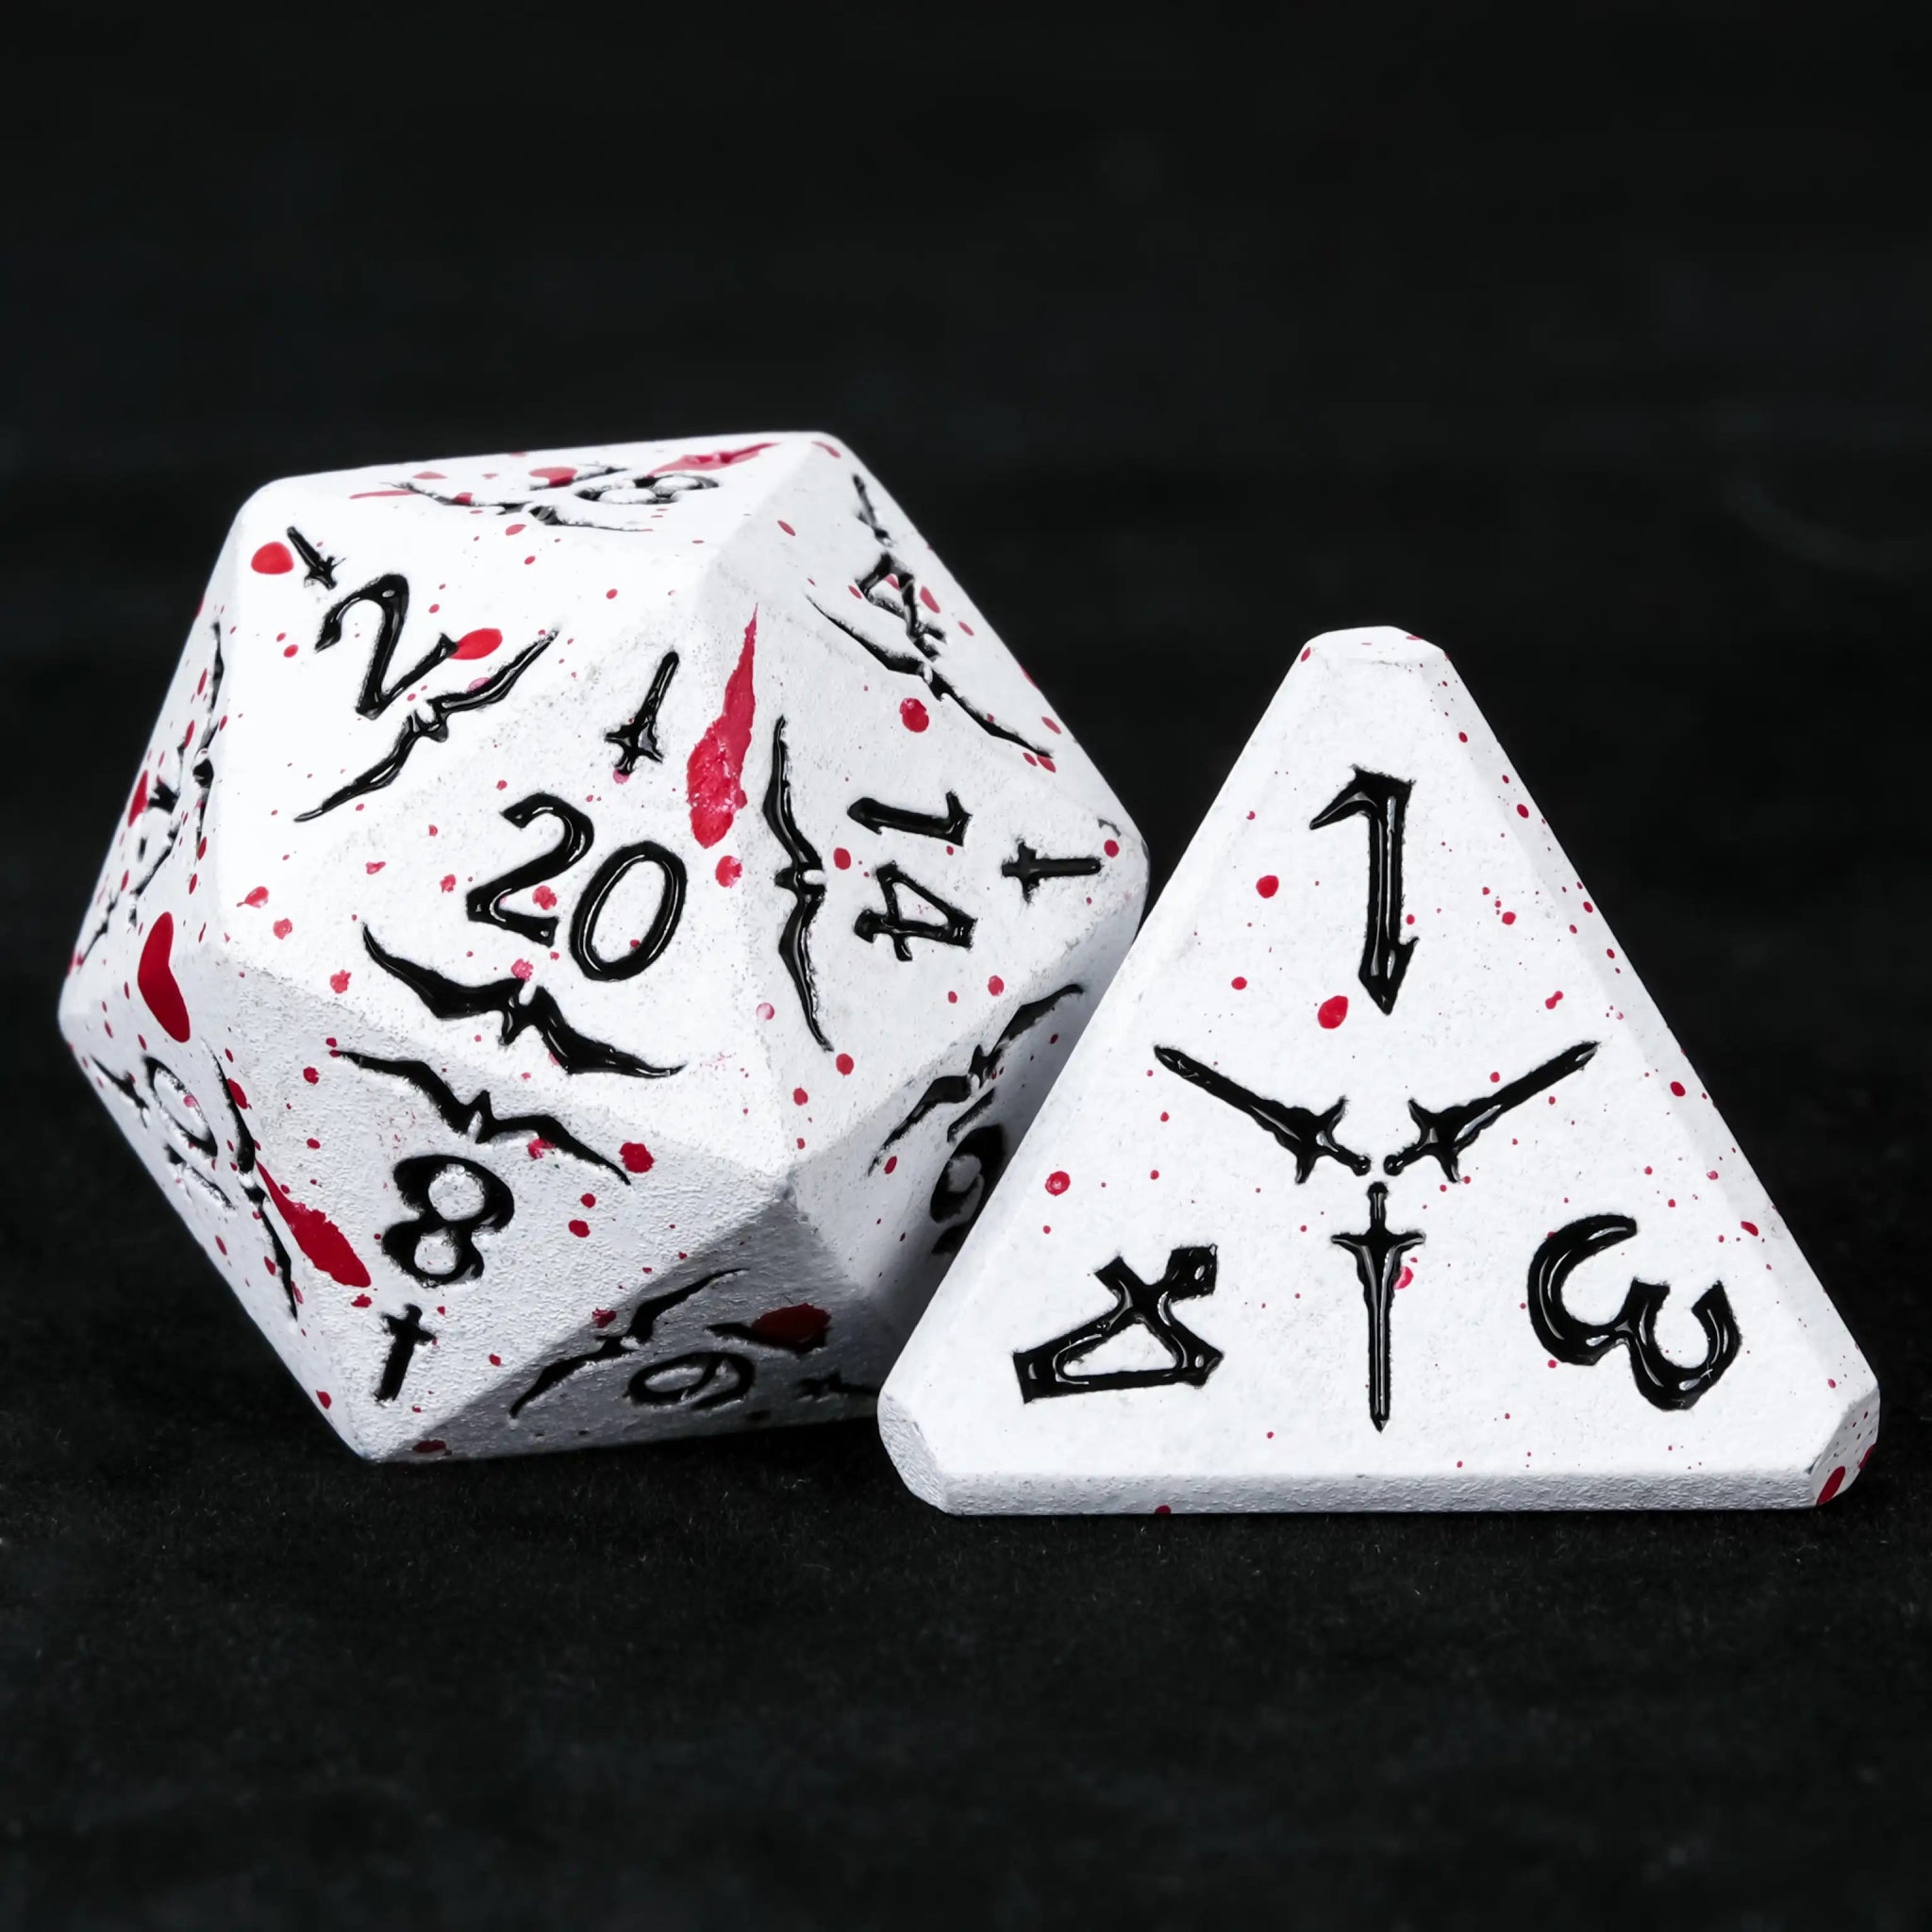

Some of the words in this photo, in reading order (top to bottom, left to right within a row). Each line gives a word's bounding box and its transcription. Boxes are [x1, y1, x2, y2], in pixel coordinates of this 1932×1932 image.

[315, 574, 459, 721] 2
[857, 553, 947, 660] 4
[465, 792, 688, 983] 20
[846, 791, 978, 961] 14
[1309, 766, 1420, 1016] 1
[380, 1153, 515, 1289] 8
[1012, 1243, 1224, 1405] 4
[1526, 1214, 1742, 1412] 3
